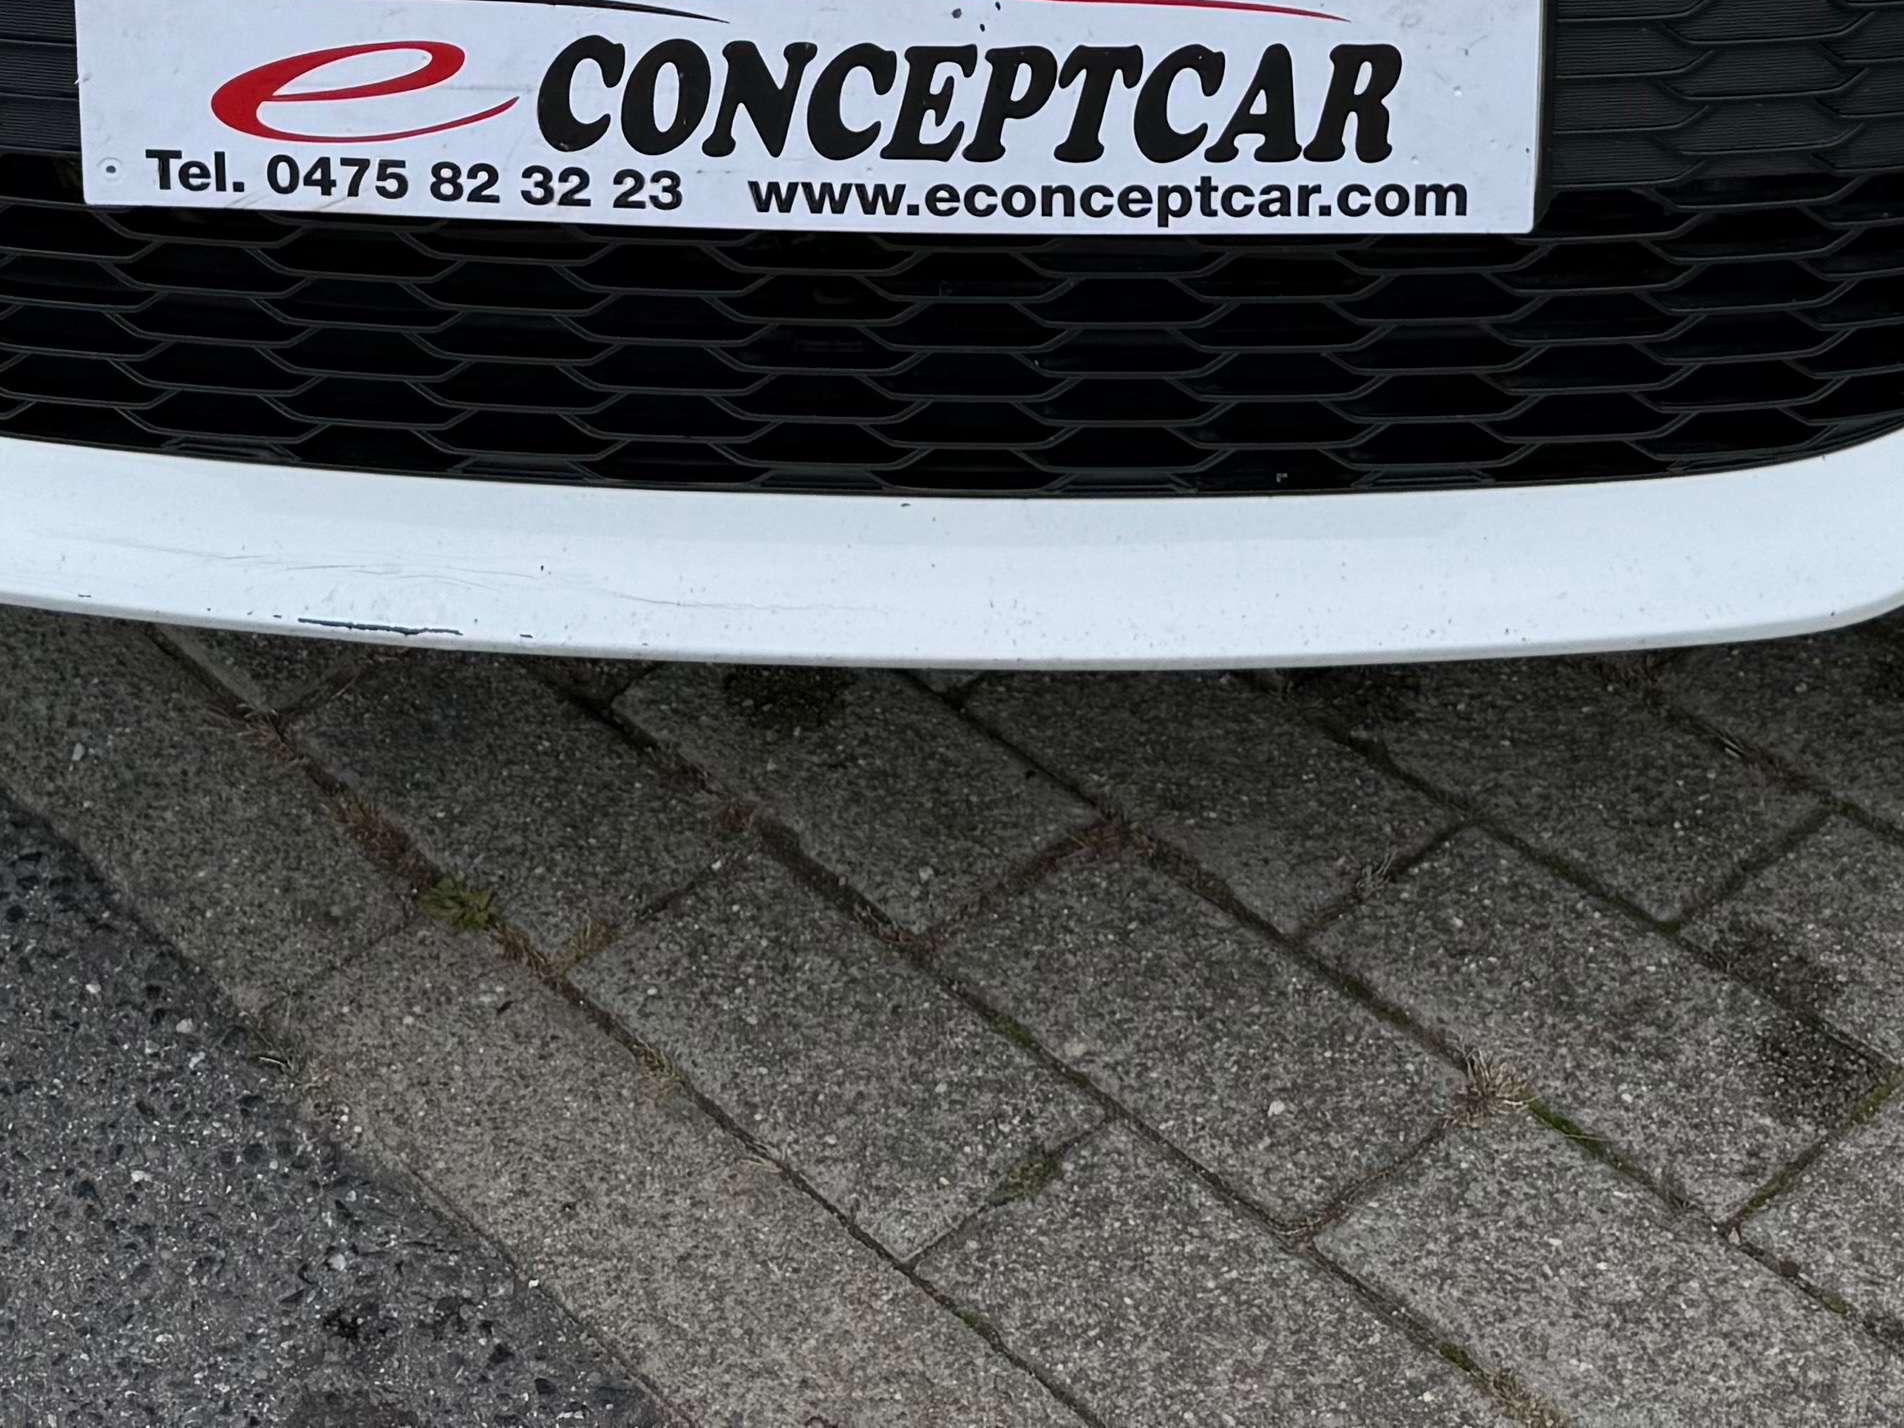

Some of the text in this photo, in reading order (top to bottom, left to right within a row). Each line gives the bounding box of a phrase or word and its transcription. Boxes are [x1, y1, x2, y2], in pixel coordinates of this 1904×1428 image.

[536, 34, 1403, 164] CONCEPTCAR
[145, 148, 1468, 228] Tel. 0475 82 32 23 www.econceptcar.com
